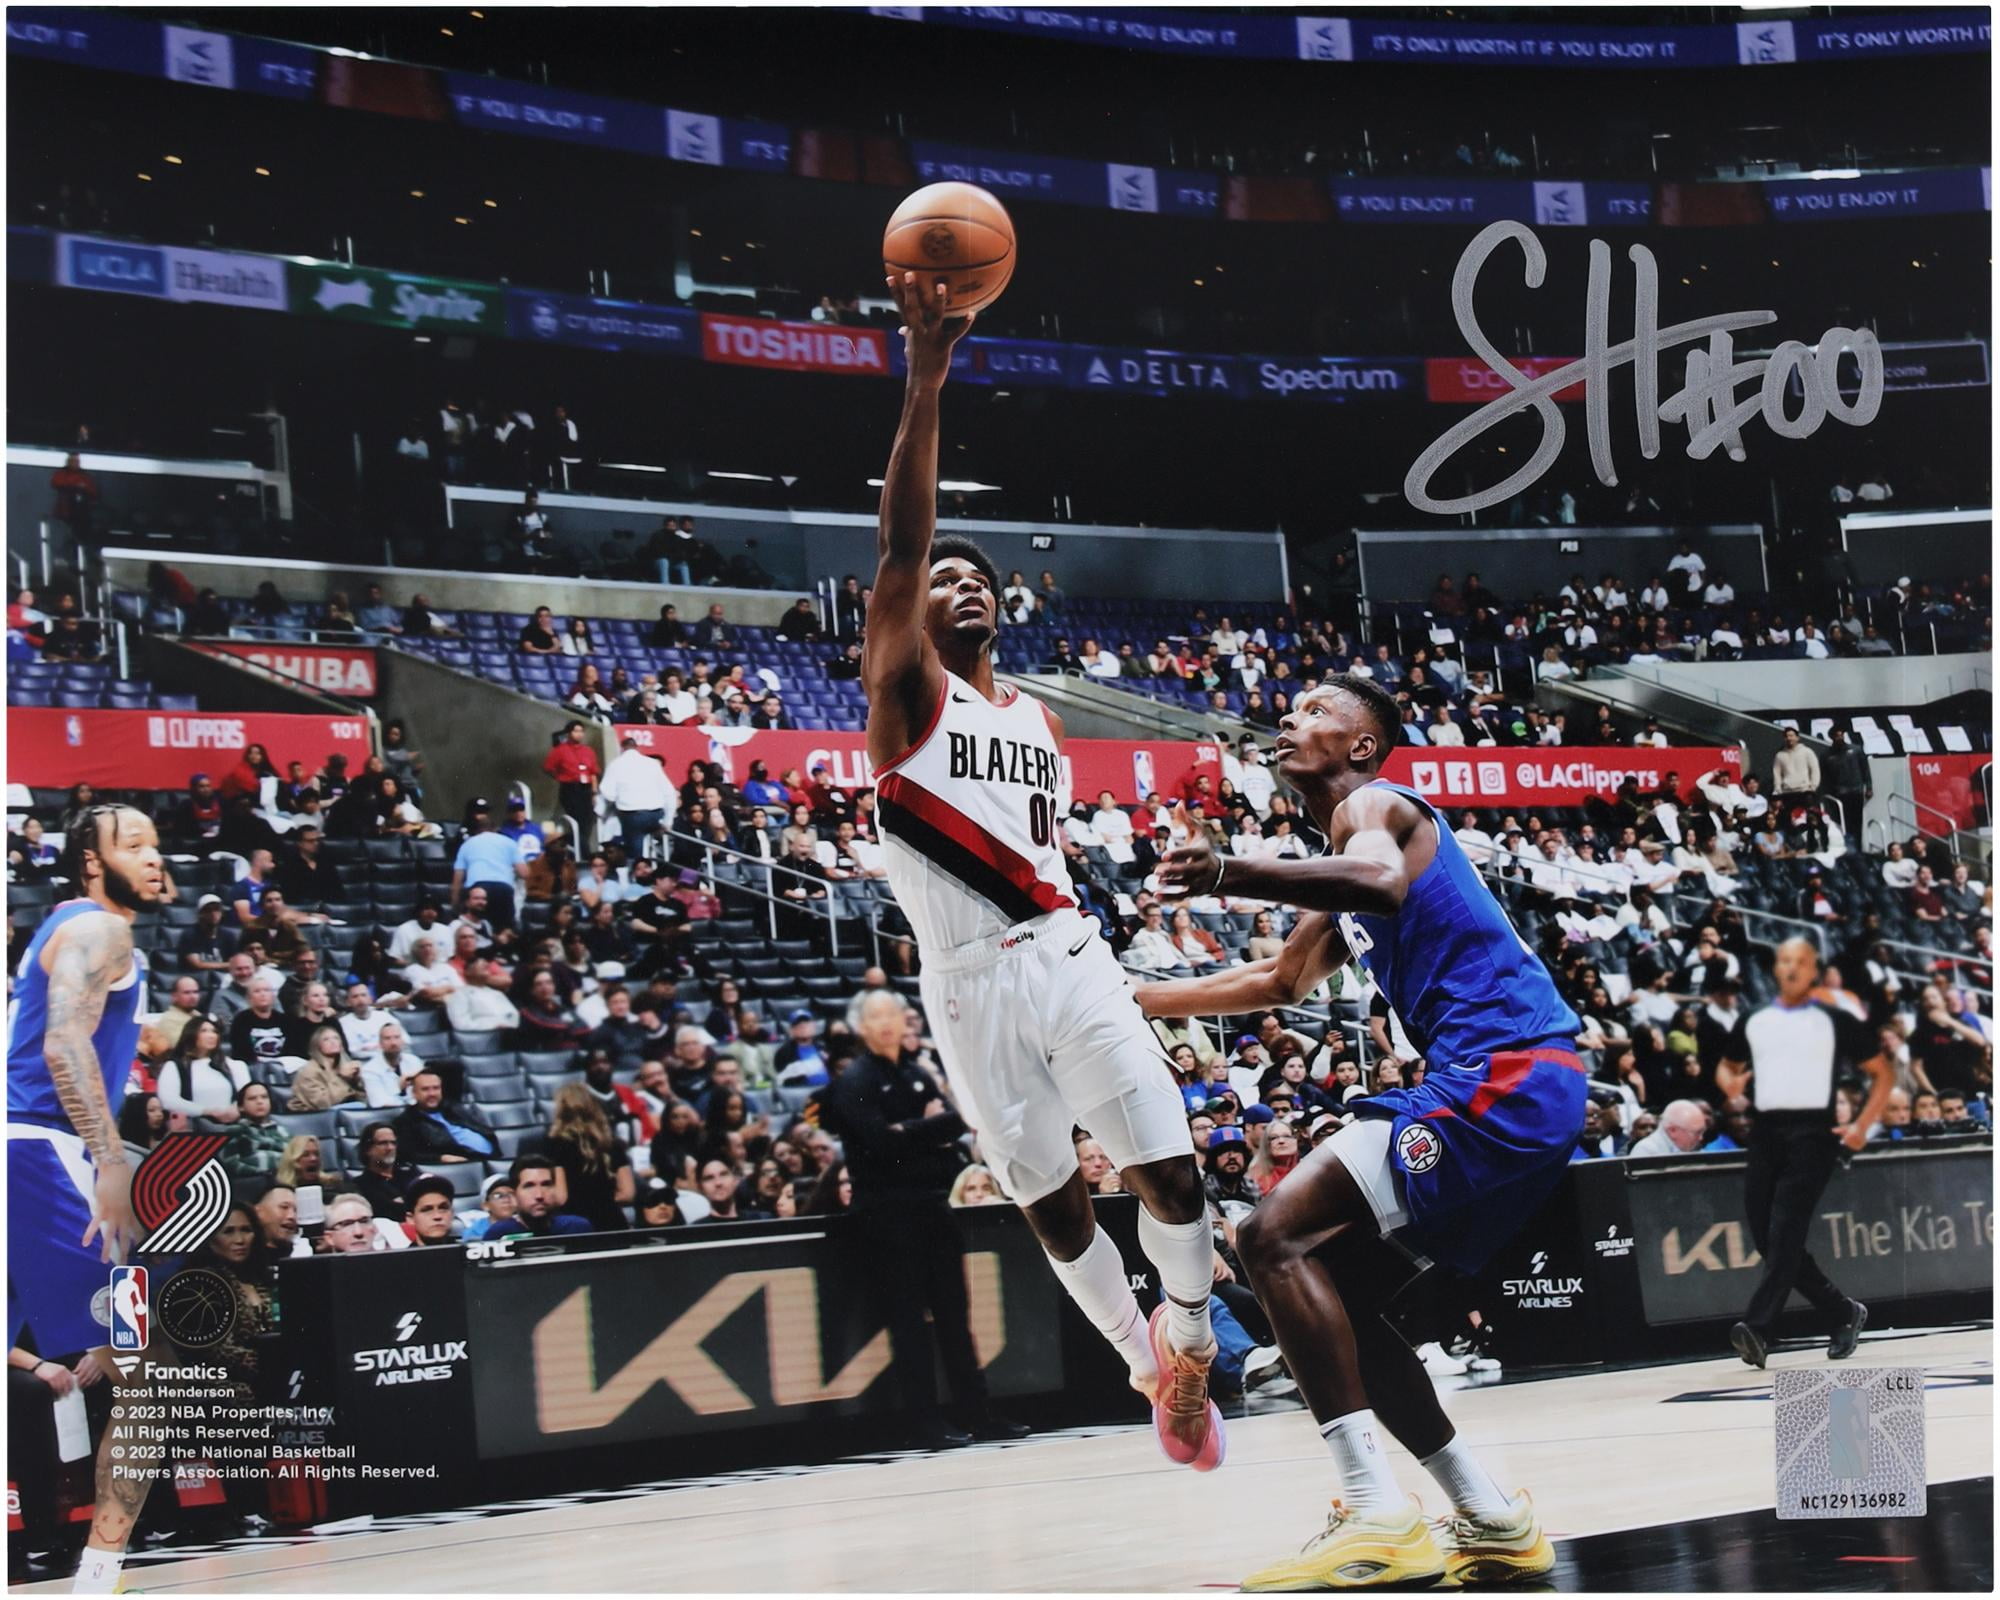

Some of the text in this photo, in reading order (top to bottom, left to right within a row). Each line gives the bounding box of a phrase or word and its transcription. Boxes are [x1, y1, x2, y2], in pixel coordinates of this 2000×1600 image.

[1125, 22, 1156, 41] YOU
[1160, 26, 1215, 45] ENJOY
[1817, 33, 1851, 50] IT'S
[1854, 30, 1901, 49] ONLY
[1905, 26, 1975, 45] WORTH
[1373, 34, 1676, 59] IT'S ONLY WORTH IT IF YOU ENJOY IT
[1400, 196, 1453, 213] ENJOY
[1773, 188, 1920, 211] IF YOU ENJOY IT
[78, 251, 278, 301] UCLA Health
[708, 322, 882, 368] TOSHIBA
[987, 350, 1062, 374] ULTRA
[1120, 359, 1230, 389] DELTA
[1259, 362, 1399, 396] Spectrum
[169, 718, 246, 749] CLIPPERS
[329, 721, 361, 739] 101
[946, 731, 1060, 796] BLAZERS
[1916, 762, 1942, 777] 104
[1000, 930, 1035, 950] ripcity
[1821, 1211, 1892, 1260] The
[1901, 1204, 1957, 1253] Kia
[465, 1239, 516, 1260] anc
[1502, 1277, 1584, 1296] STARLUX
[1517, 1296, 1573, 1309] AIRLINES
[353, 1340, 469, 1372] STARLUX
[375, 1364, 454, 1387] AIRLINES
[1885, 1376, 1914, 1390] LCL
[1801, 1492, 1907, 1510] NC129136982
